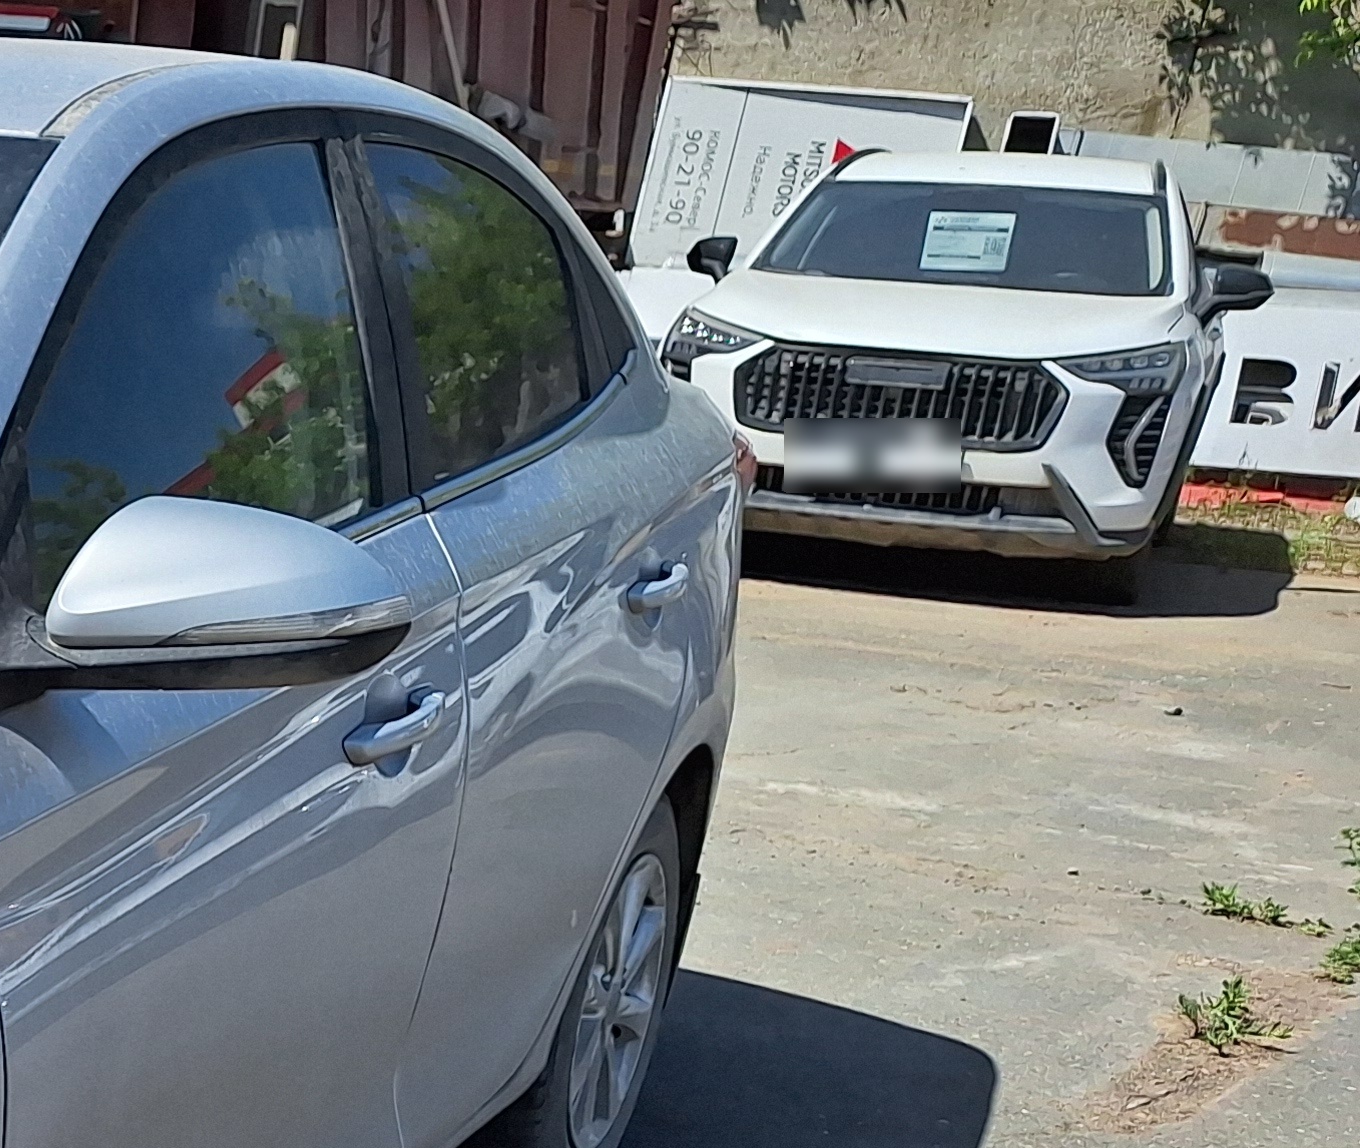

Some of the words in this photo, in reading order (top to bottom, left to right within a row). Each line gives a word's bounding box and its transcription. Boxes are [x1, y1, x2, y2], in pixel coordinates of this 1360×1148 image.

[665, 129, 703, 225] 90-21-90
[772, 152, 802, 217] MOTORS
[799, 141, 827, 195] MITSU
